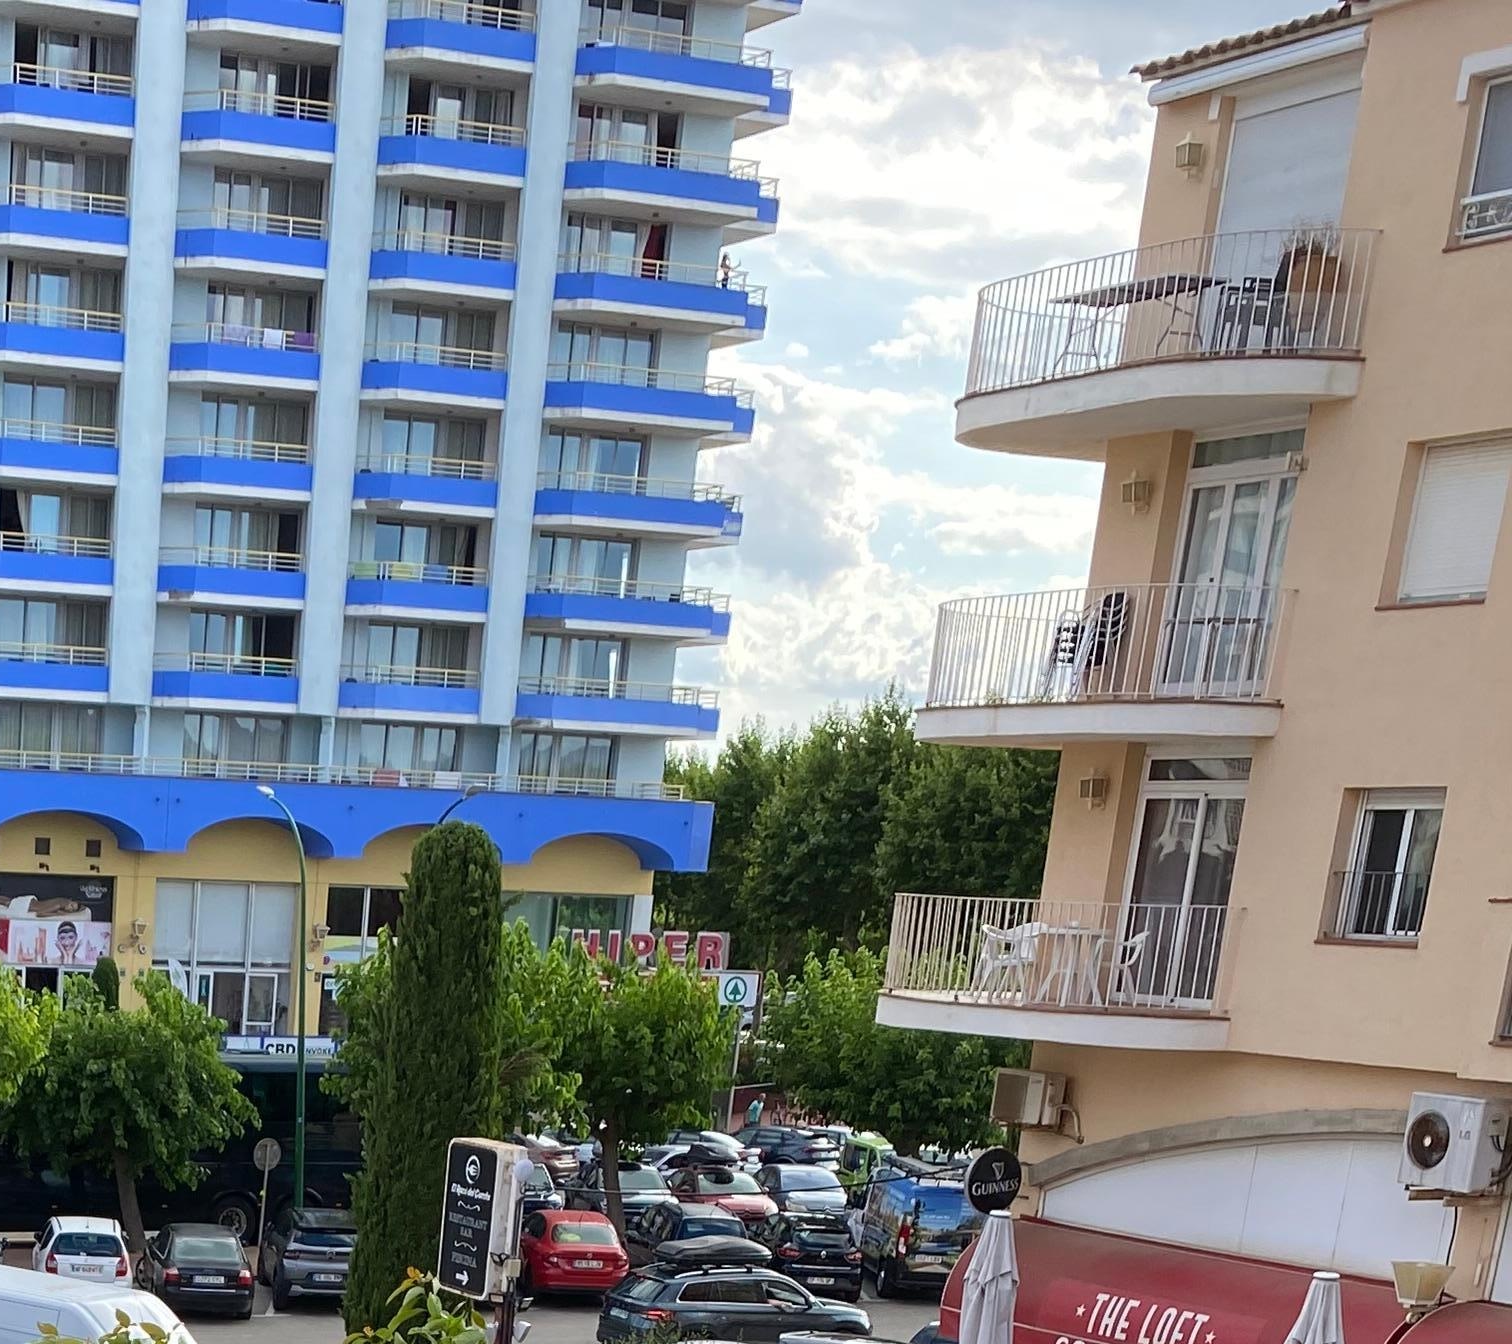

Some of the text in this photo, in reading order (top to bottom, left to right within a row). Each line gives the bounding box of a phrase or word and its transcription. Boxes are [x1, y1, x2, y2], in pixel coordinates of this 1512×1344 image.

[571, 929, 727, 970] HIPER
[972, 1177, 1019, 1197] GUINNESS
[1087, 1293, 1141, 1341] THE
